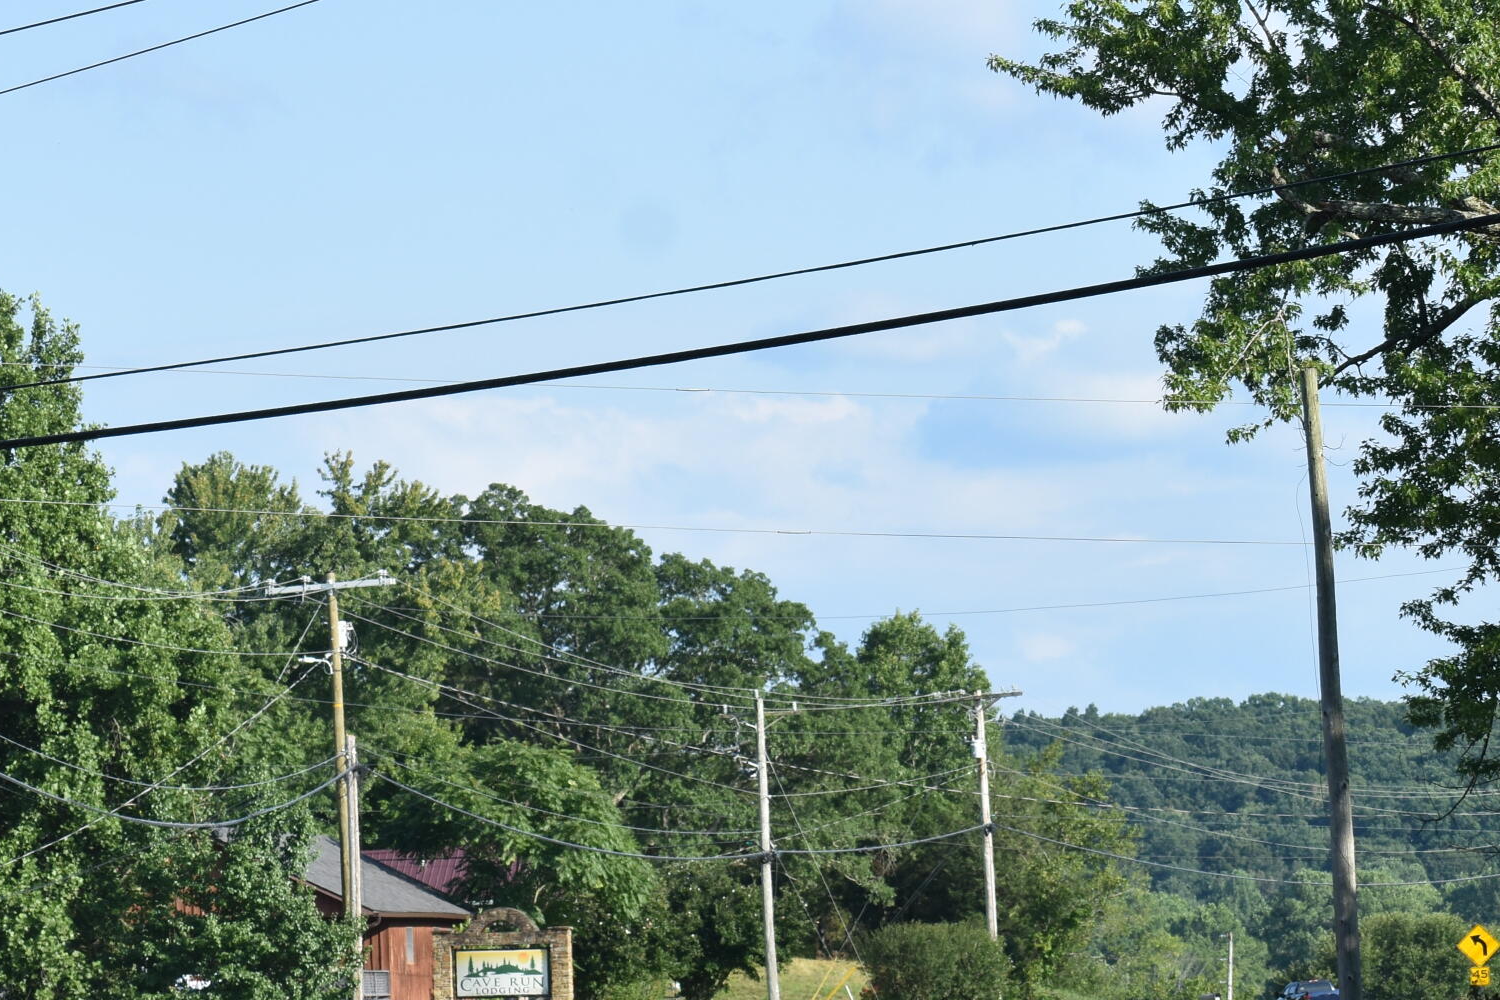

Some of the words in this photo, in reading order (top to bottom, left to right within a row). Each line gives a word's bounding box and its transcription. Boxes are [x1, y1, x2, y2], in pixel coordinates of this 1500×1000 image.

[1472, 969, 1488, 979] 45
[460, 976, 501, 992] CAVE
[510, 975, 545, 990] RUN
[475, 986, 530, 995] LODGING
